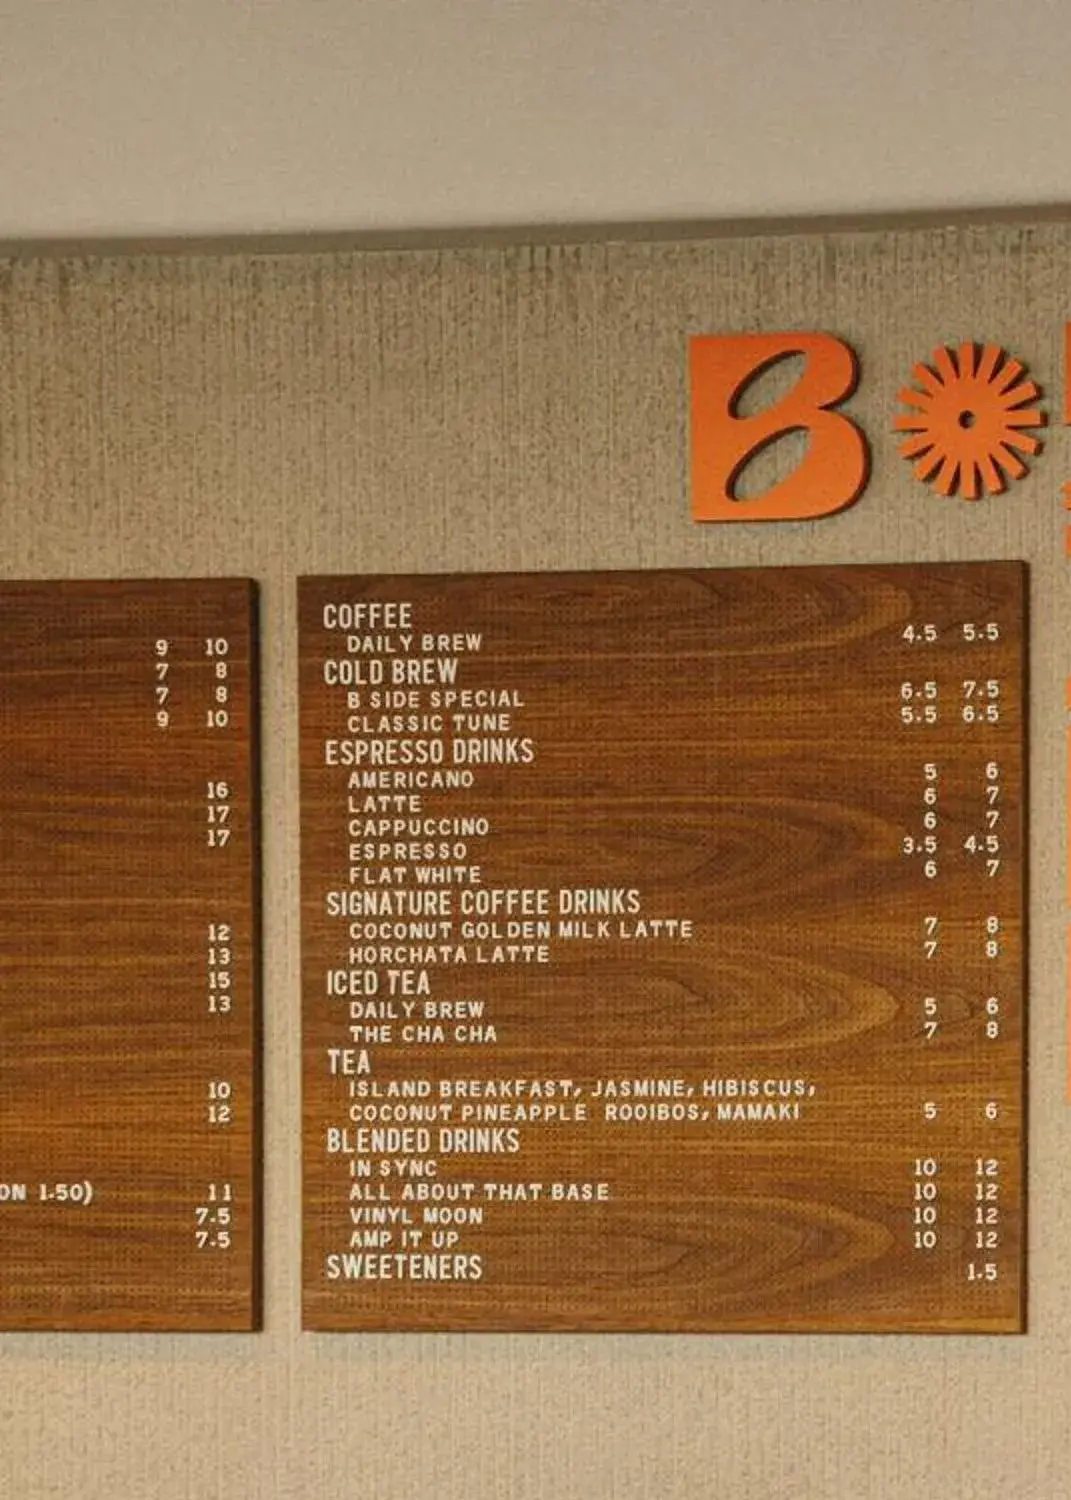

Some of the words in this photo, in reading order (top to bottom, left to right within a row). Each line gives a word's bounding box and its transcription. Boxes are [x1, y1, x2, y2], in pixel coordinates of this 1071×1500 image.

[690, 331, 872, 523] B
[323, 603, 412, 629] COFFEE
[902, 624, 938, 644] 4.5
[963, 622, 999, 642] 5.5
[155, 639, 169, 657] 9
[206, 637, 229, 656] 10
[347, 634, 413, 653] DAILY
[421, 633, 482, 652] BREW
[155, 662, 169, 681] 7
[215, 661, 228, 679] 8
[323, 659, 383, 685] COLD
[392, 657, 458, 685] BREW
[155, 686, 169, 705] 7
[215, 685, 228, 703] 8
[347, 691, 361, 709] B
[370, 690, 419, 709] SIDE
[430, 689, 524, 709] SPECIAL
[900, 681, 937, 701] 6.5
[963, 679, 999, 699] 7.5
[156, 709, 169, 728] 9
[207, 709, 229, 728] 10
[347, 714, 443, 733] CLASSIC
[452, 713, 510, 732] TUNE
[901, 705, 937, 724] 5.5
[962, 703, 999, 723] 6.5
[325, 738, 444, 765] ESPRESSO
[453, 738, 534, 764] DRINKS
[348, 770, 474, 789] AMERICANO
[924, 763, 938, 781] 5
[985, 761, 999, 780] 6
[207, 781, 229, 799] 16
[923, 787, 937, 805] 6
[986, 785, 999, 805] 7
[348, 794, 421, 813] LATTE
[207, 805, 230, 823] 17
[923, 811, 937, 830] 6
[986, 810, 1000, 829] 7
[348, 817, 489, 837] CAPPUCCINO
[207, 829, 231, 847] 17
[903, 835, 937, 855] 3.5
[964, 834, 999, 854] 4.5
[349, 842, 467, 861] ESPRESSO
[349, 866, 407, 885] FLAT
[415, 865, 481, 884] WHITE
[924, 860, 937, 878] 6
[986, 859, 1000, 877] 7
[326, 890, 452, 916] SIGNATURE
[461, 889, 549, 916] COFFEE
[559, 888, 641, 915] DRINKS
[208, 923, 230, 942] 12
[349, 921, 453, 940] COCONUT
[461, 921, 551, 940] GOLDEN
[558, 920, 610, 939] MILK
[619, 919, 693, 939] LATTE
[924, 916, 938, 936] 7
[986, 915, 999, 934] 8
[208, 947, 231, 965] 13
[349, 945, 467, 964] HORCHATA
[476, 944, 549, 963] LATTE
[924, 940, 938, 959] 7
[985, 940, 998, 958] 8
[209, 971, 231, 989] 15
[327, 969, 378, 996] ICED
[387, 969, 431, 995] TEA
[208, 995, 231, 1013] 13
[350, 1001, 415, 1019] DAILY
[424, 1001, 484, 1019] BREW
[924, 997, 937, 1015] 5
[986, 996, 999, 1015] 6
[349, 1025, 392, 1043] THE
[401, 1025, 445, 1043] CHA
[454, 1025, 497, 1043] CHA
[923, 1021, 938, 1039] 7
[986, 1020, 999, 1039] 8
[327, 1048, 371, 1075] TEA
[209, 1081, 231, 1099] 10
[349, 1080, 431, 1098] ISLAND
[439, 1079, 582, 1098] BREAKFAST,
[591, 1079, 695, 1097] JASMINE,
[703, 1079, 815, 1097] HIBISCUS,
[209, 1104, 231, 1123] 12
[349, 1103, 453, 1122] COCONUT
[461, 1103, 587, 1122] PINEAPPLE
[605, 1103, 710, 1121] ROOIBOS,
[717, 1103, 799, 1121] MAMAKI
[924, 1102, 937, 1120] 5
[985, 1101, 997, 1120] 6
[327, 1127, 430, 1153] BLENDED
[439, 1127, 519, 1153] DRINKS
[349, 1159, 371, 1177] IN
[379, 1159, 437, 1177] SYNC
[914, 1157, 937, 1177] 10
[975, 1158, 998, 1176] 12
[208, 1183, 232, 1202] 11
[349, 1183, 391, 1201] ALL
[401, 1183, 475, 1201] ABOUT
[483, 1183, 543, 1201] THAT
[551, 1183, 609, 1201] BASE
[914, 1182, 937, 1201] 10
[975, 1182, 998, 1201] 12
[195, 1207, 231, 1226] 7.5
[350, 1206, 413, 1224] VINYL
[423, 1207, 483, 1225] MOON
[914, 1206, 937, 1225] 10
[975, 1206, 998, 1225] 12
[195, 1231, 231, 1249] 7.5
[349, 1229, 392, 1248] AMP
[401, 1230, 423, 1248] IT
[431, 1231, 459, 1249] UP
[914, 1230, 937, 1249] 10
[975, 1231, 998, 1249] 12
[327, 1253, 482, 1280] SWEETENERS
[967, 1263, 997, 1281] 1.5
